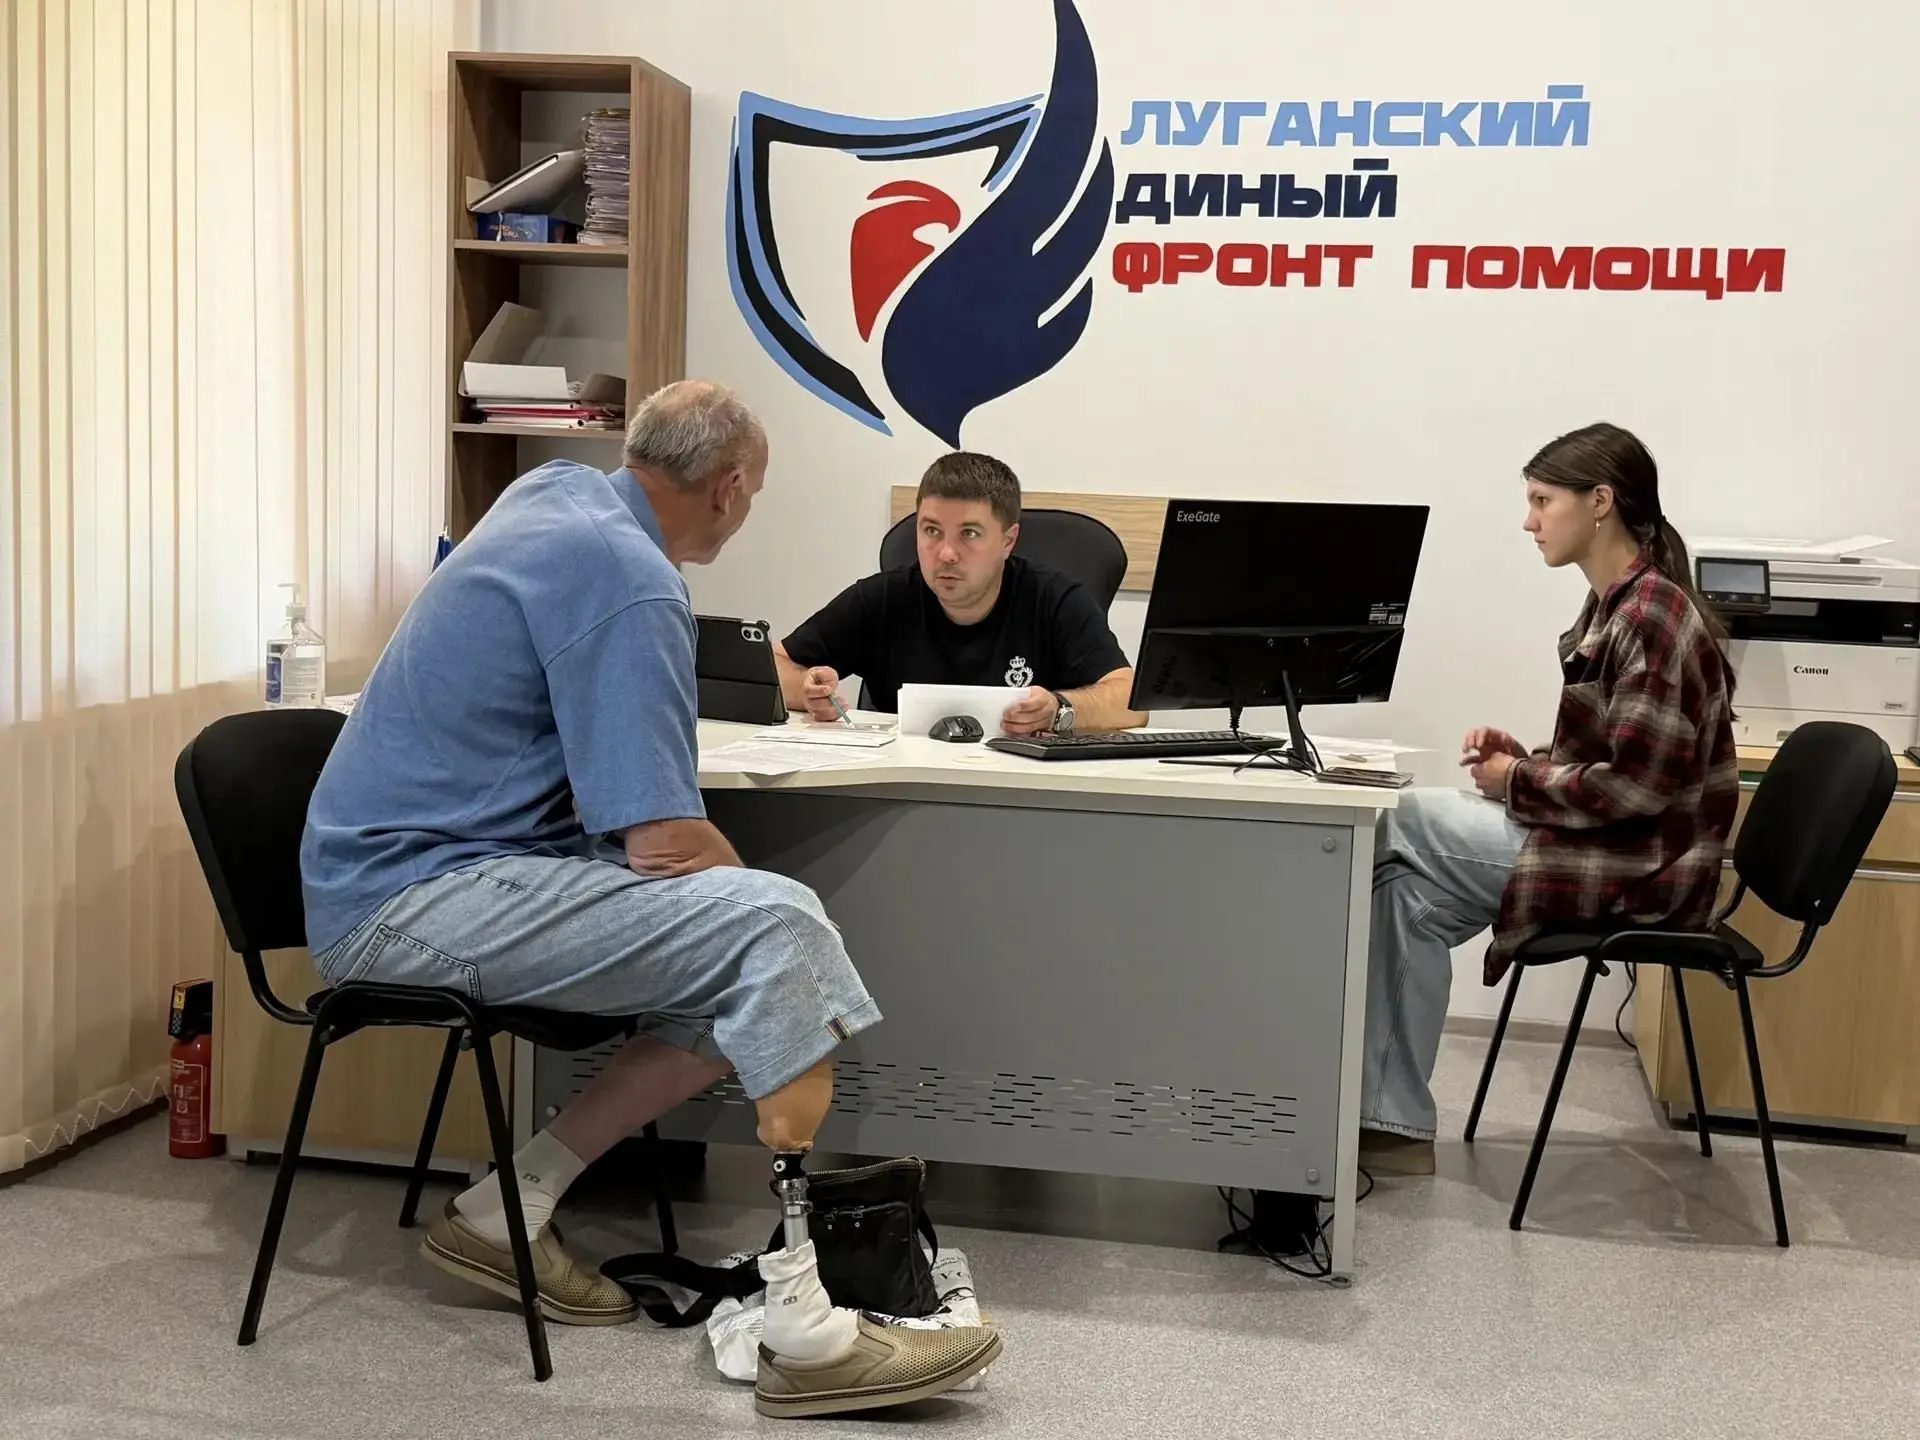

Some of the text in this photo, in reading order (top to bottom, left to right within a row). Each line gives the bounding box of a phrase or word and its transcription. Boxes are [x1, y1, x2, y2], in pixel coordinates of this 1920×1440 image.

[1120, 85, 1591, 147] ЛУГАНСКИЙ
[1115, 158, 1398, 225] ДИНЫЙ
[1112, 242, 1787, 301] ФРОНТ ПОМОЩИ
[1176, 510, 1221, 523] ExeGate
[1793, 665, 1830, 676] Canon
